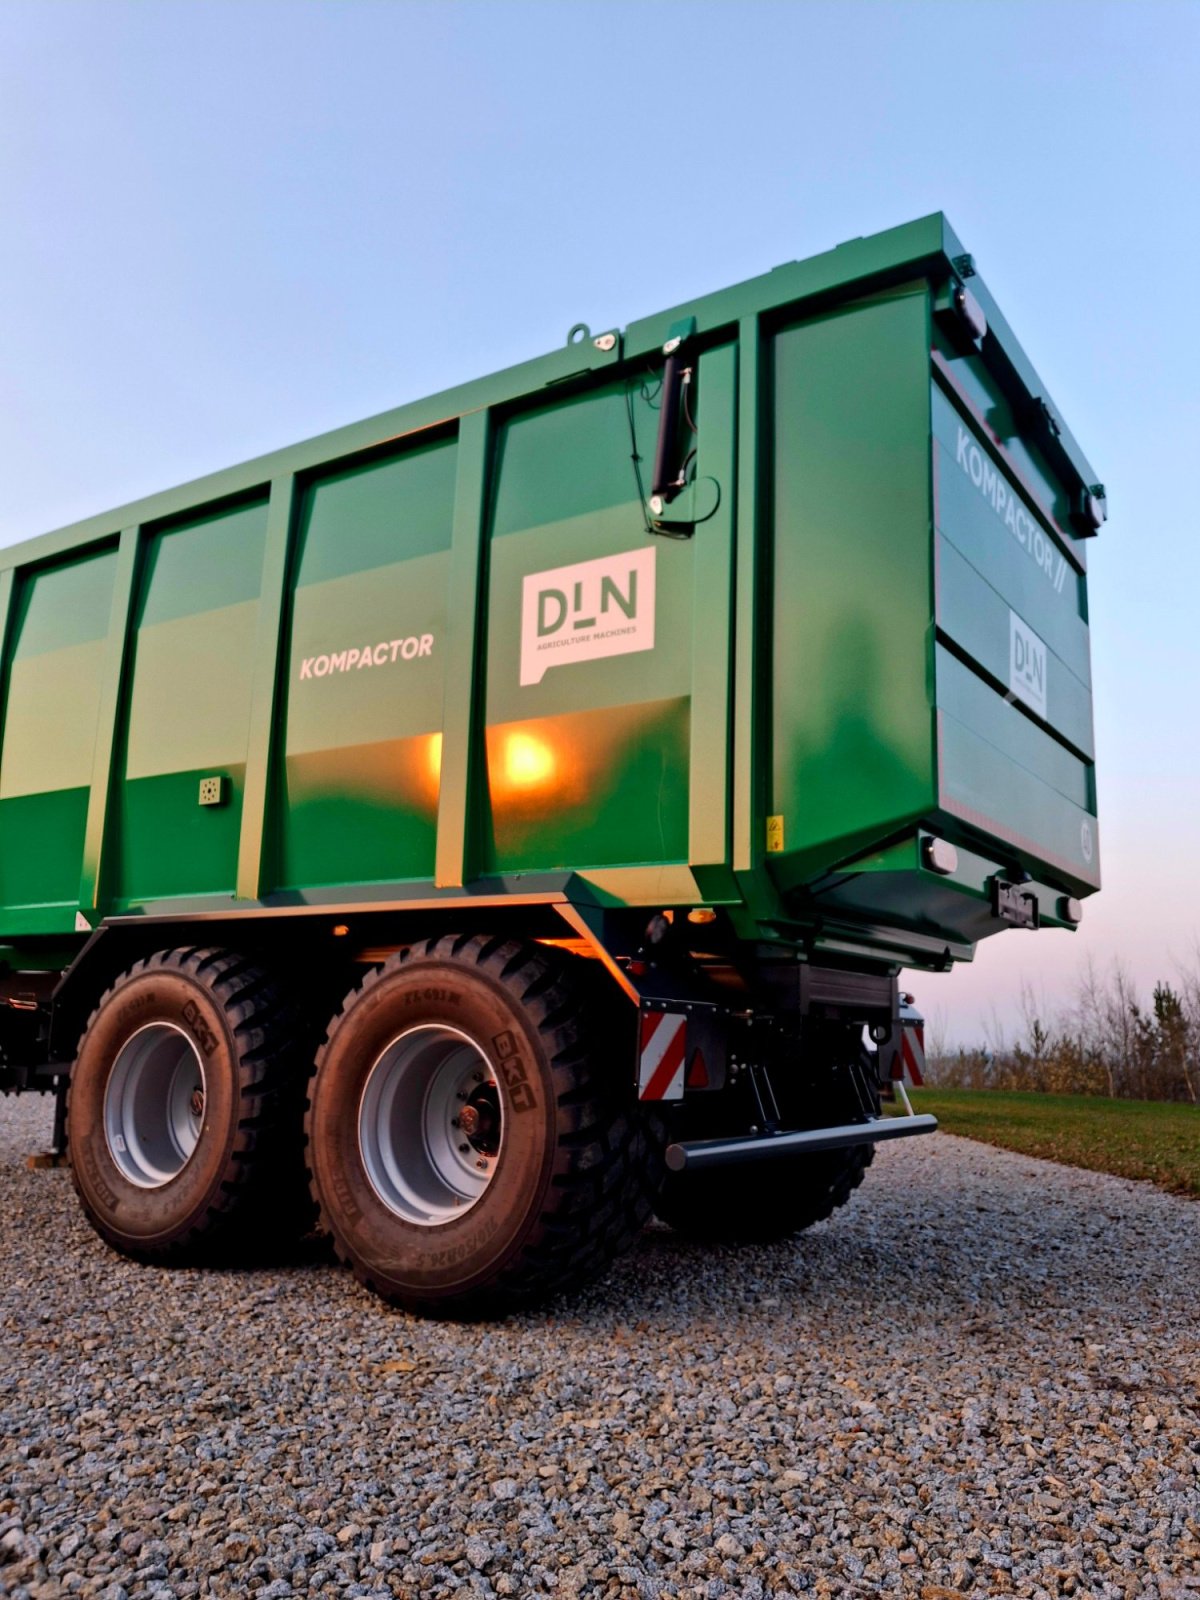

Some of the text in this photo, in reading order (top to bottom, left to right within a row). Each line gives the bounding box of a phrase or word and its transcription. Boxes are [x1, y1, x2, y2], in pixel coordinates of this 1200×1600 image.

[957, 427, 1052, 578] KOMPACTOR
[300, 633, 434, 680] KOMPACTOR
[536, 626, 637, 651] AGRICULTURE MACHINES
[182, 1000, 219, 1057] BKT
[493, 1030, 536, 1113] BKT
